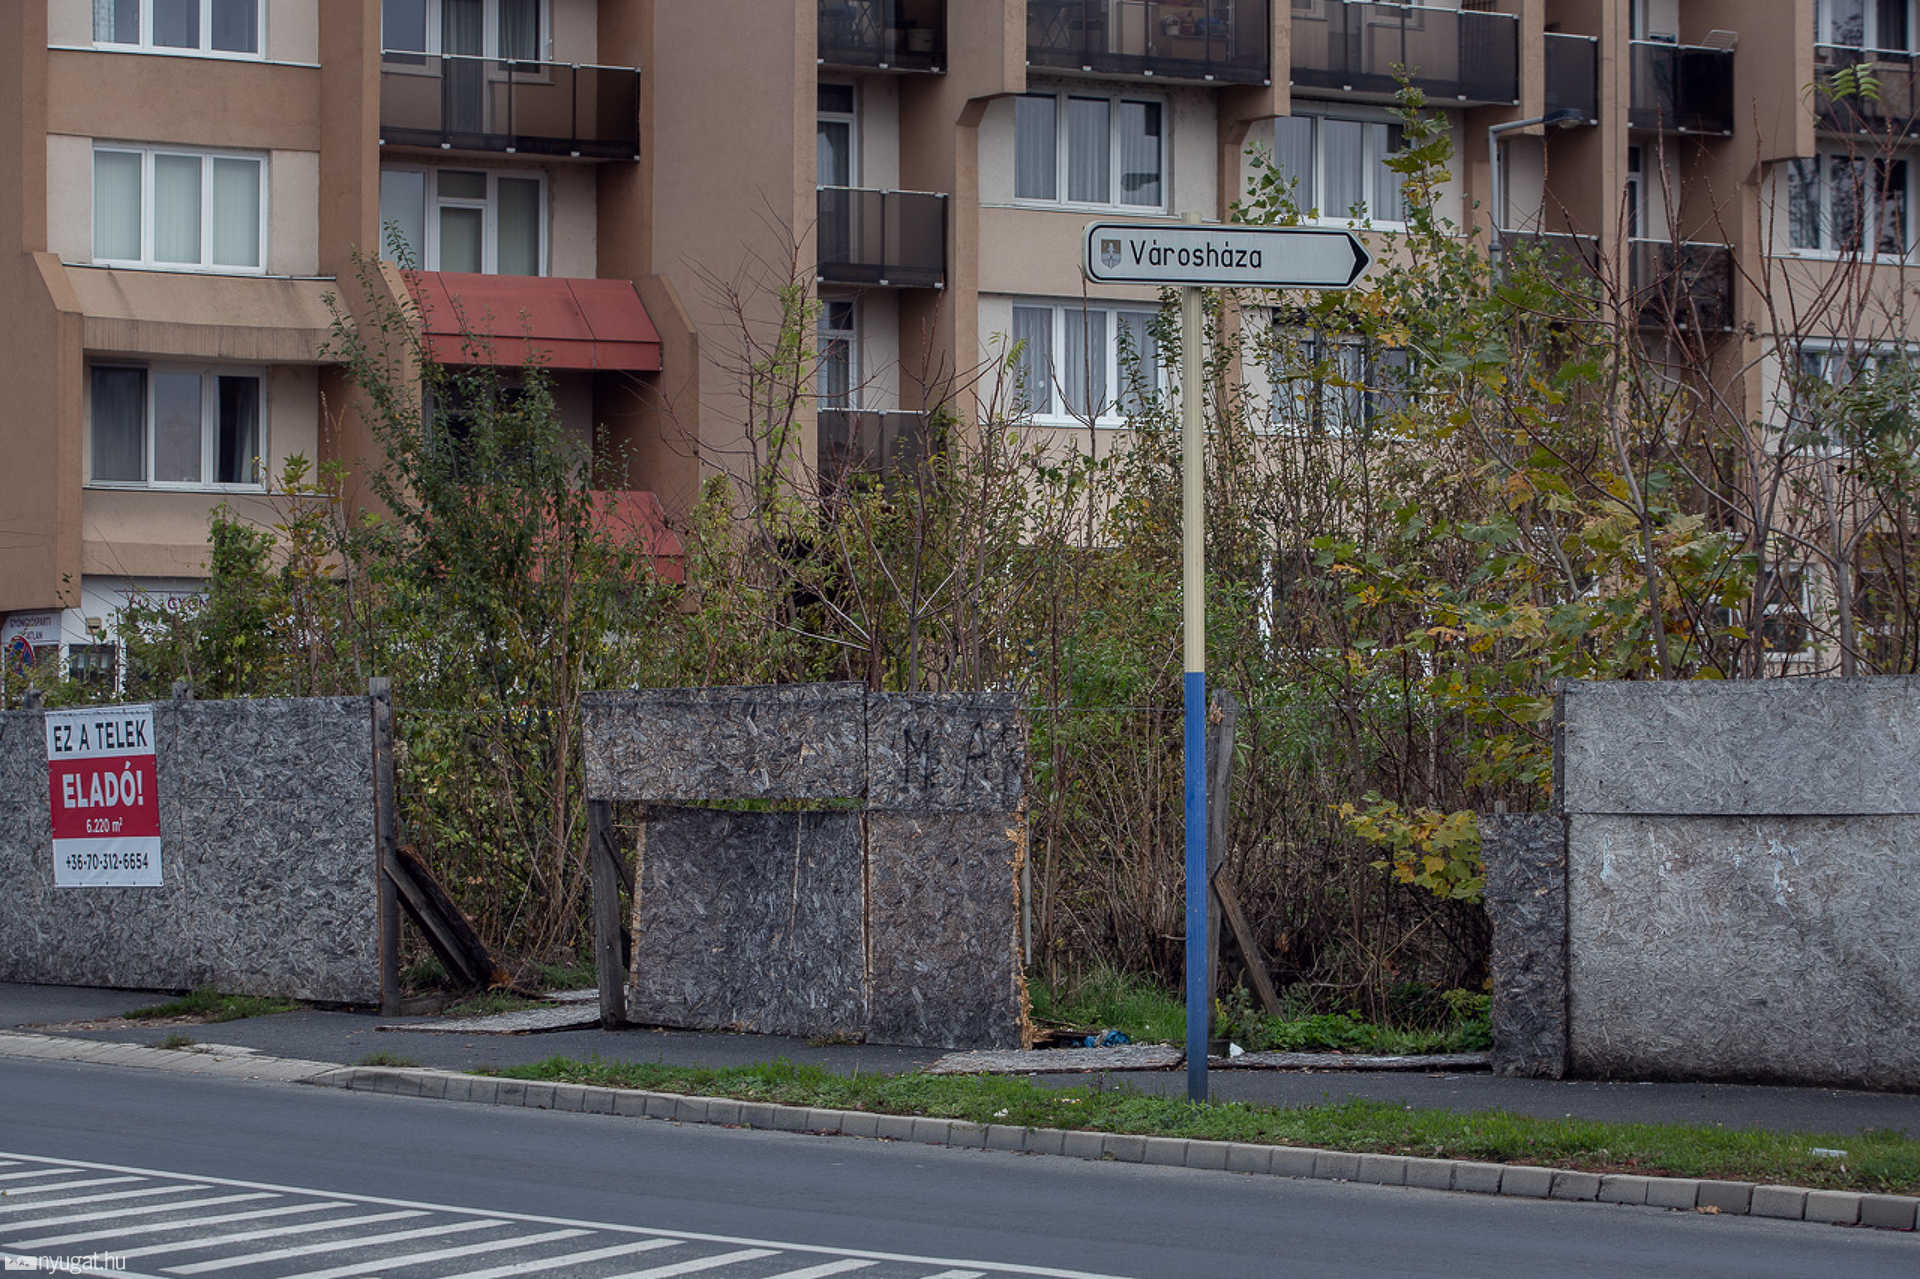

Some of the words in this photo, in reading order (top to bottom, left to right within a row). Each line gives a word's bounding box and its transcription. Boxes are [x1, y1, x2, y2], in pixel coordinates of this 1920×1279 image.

[1129, 239, 1262, 268] Városháza
[53, 725, 73, 752] EZ
[79, 723, 90, 750] A
[95, 719, 148, 750] TELEK
[62, 760, 144, 809] ELADÓ!
[86, 818, 110, 833] 6.220
